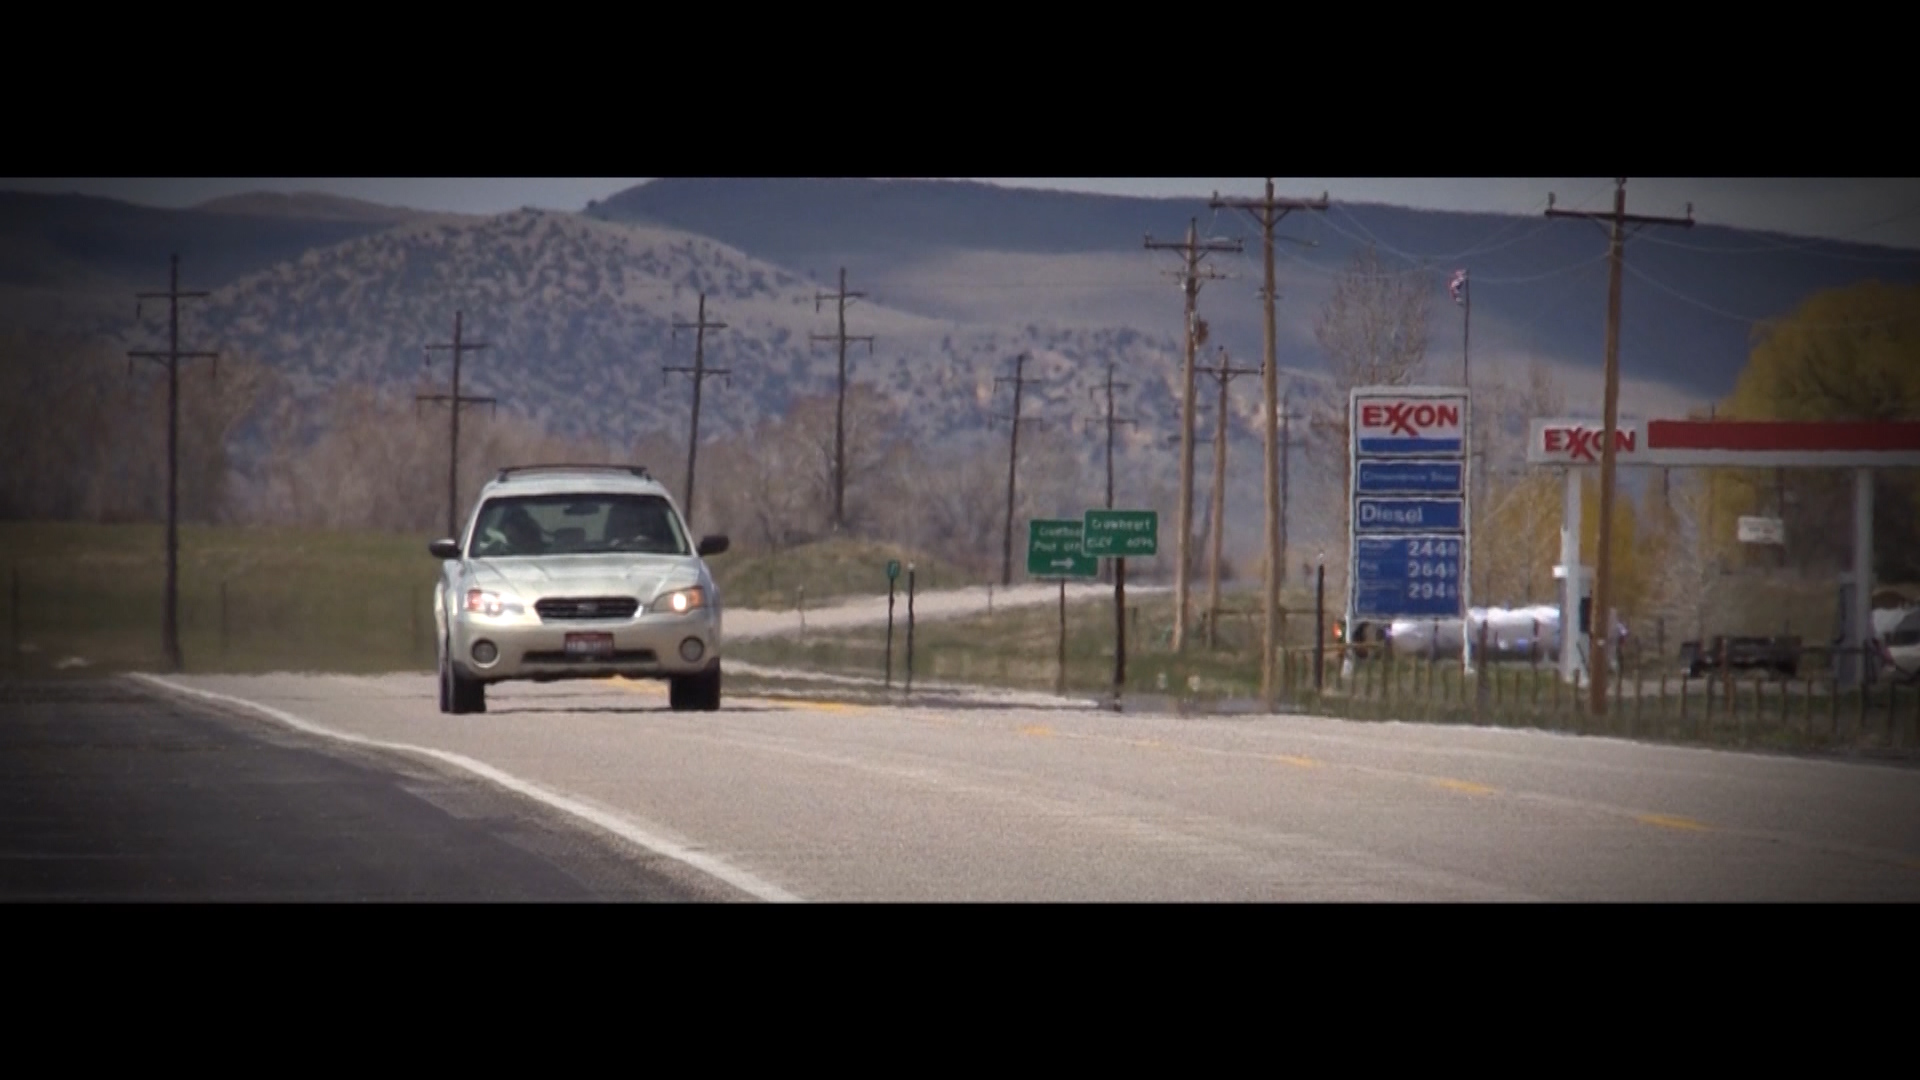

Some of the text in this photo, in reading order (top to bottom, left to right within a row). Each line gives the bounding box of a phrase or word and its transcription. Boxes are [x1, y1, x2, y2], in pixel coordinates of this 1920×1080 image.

[1362, 401, 1459, 437] EXXON
[1544, 426, 1636, 461] EXXON
[1361, 503, 1423, 523] Diesel
